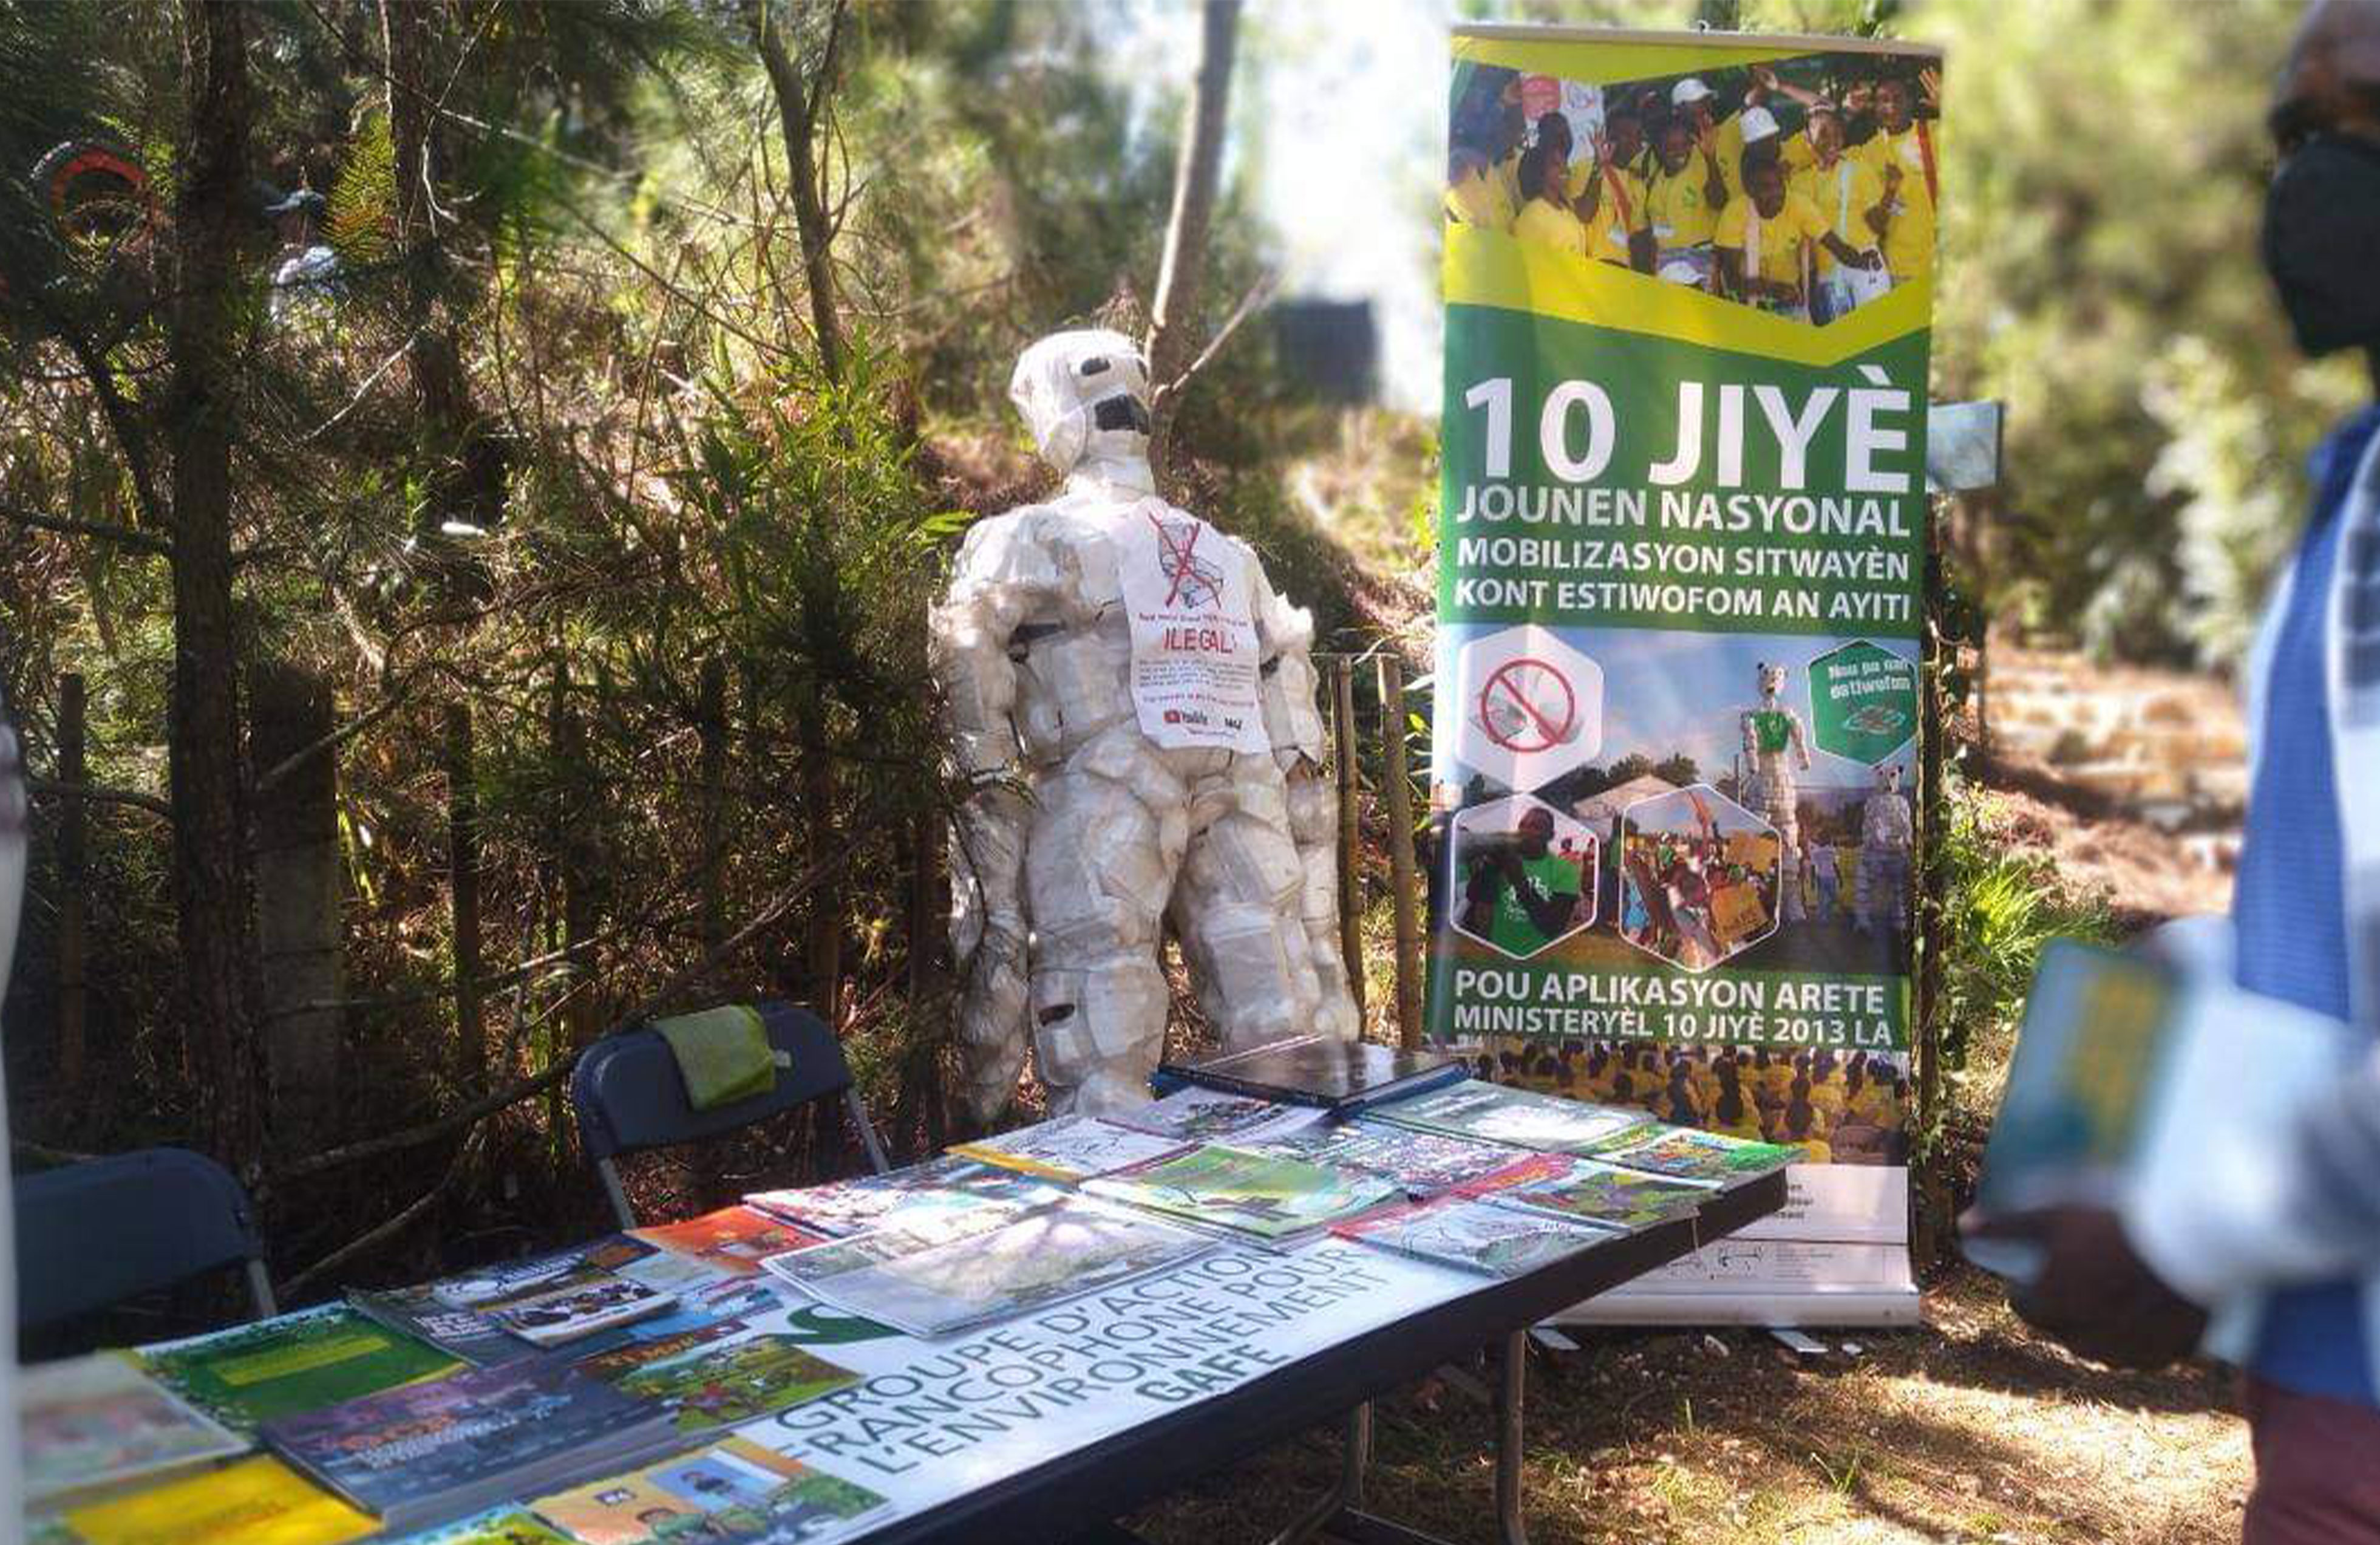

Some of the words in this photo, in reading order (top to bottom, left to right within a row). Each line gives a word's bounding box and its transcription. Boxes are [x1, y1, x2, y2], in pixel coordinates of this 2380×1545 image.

[1465, 377, 1616, 483] 10
[1648, 364, 1911, 494] JIYÈ
[1456, 485, 1648, 527] JOUNEN
[1661, 491, 1911, 537] NASYONAL
[1457, 537, 1725, 575] MOBILIZASYON
[1735, 545, 1910, 581] SITWAYÈN
[1454, 578, 1549, 607] KONT
[1557, 582, 1763, 616] ESTIWOFOM
[1771, 589, 1820, 618] AN
[1827, 592, 1910, 621] AYITI
[1455, 970, 1531, 1000] POU
[1540, 972, 1764, 1010] APLIKASYON
[1773, 981, 1884, 1014] ARETE
[1453, 1004, 1654, 1036] MINISTERYÈL
[1664, 1013, 1698, 1039] 10
[1702, 1011, 1764, 1042] JIYÈ
[1773, 1018, 1846, 1045] 2013
[1854, 1020, 1892, 1046] LA
[1223, 1247, 1363, 1300] POUR
[777, 1330, 1041, 1429] GROUPE
[1036, 1247, 1291, 1335] D'ACTION
[857, 1266, 1389, 1474] L'ENVIRONNEMENT
[1134, 1344, 1290, 1402] GAFE
